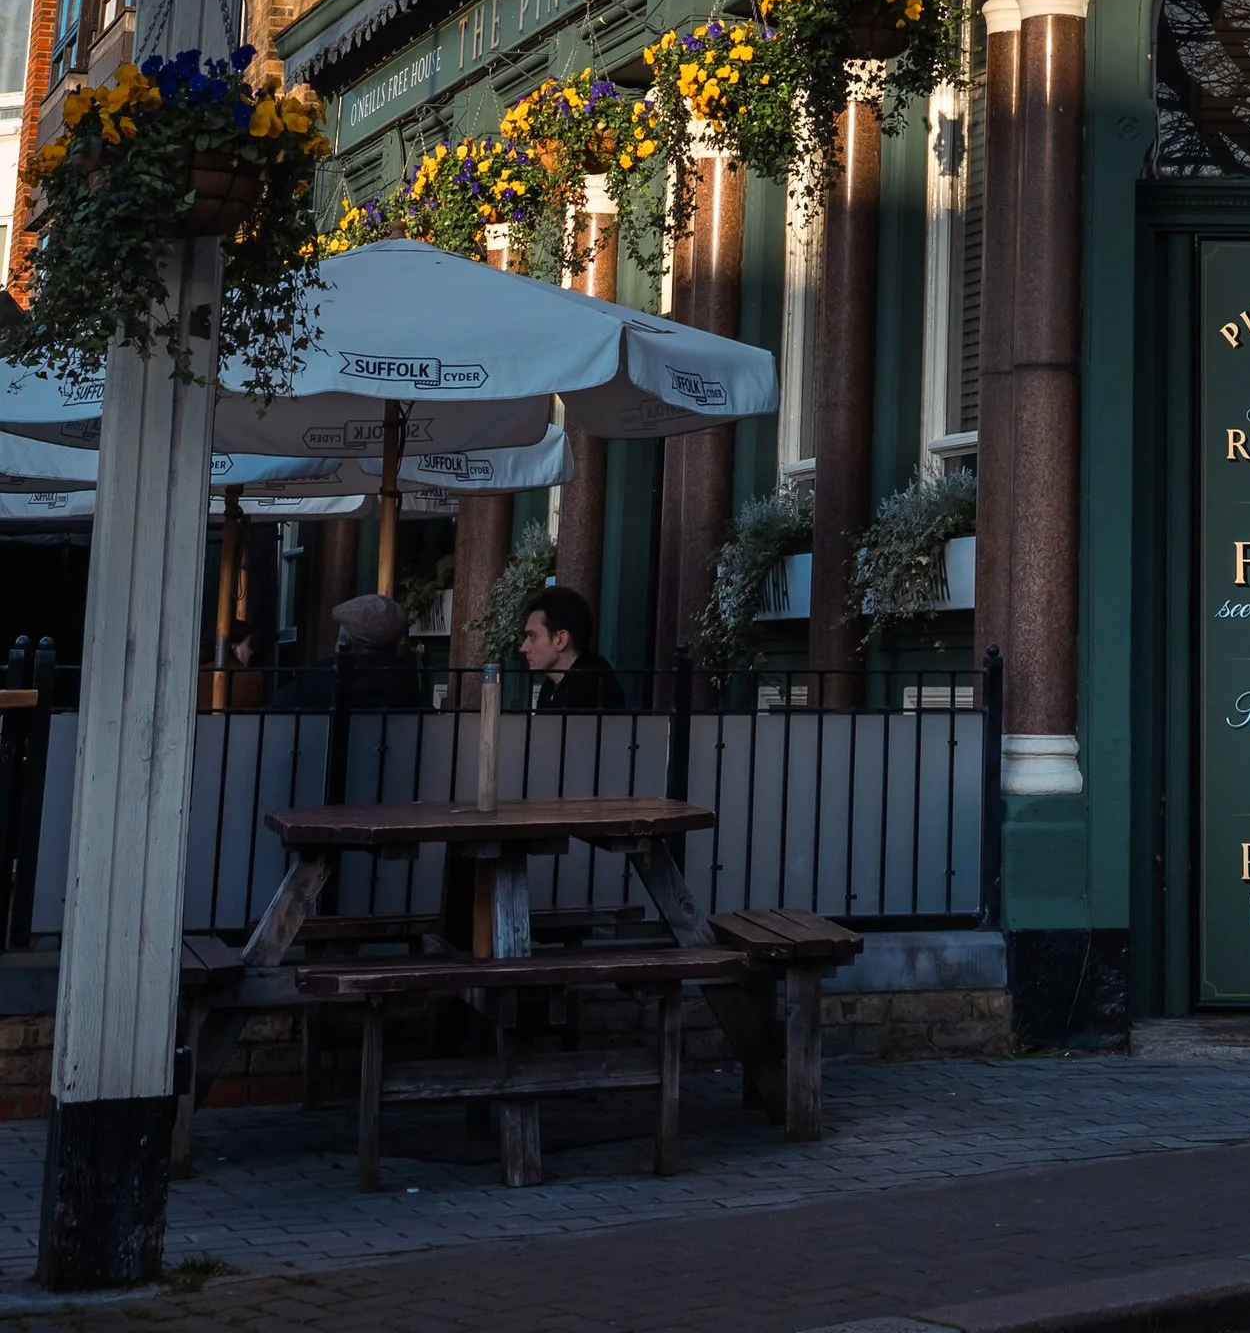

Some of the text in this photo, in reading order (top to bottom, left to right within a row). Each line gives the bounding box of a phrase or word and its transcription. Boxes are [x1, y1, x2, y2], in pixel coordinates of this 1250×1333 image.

[350, 46, 442, 126] O'NEILLS FREE HOUSE
[355, 359, 480, 381] SUFFOLK CYDER
[74, 385, 104, 400] SUFFO
[211, 460, 226, 469] DER
[424, 455, 490, 475] SUFFOLK CYDER
